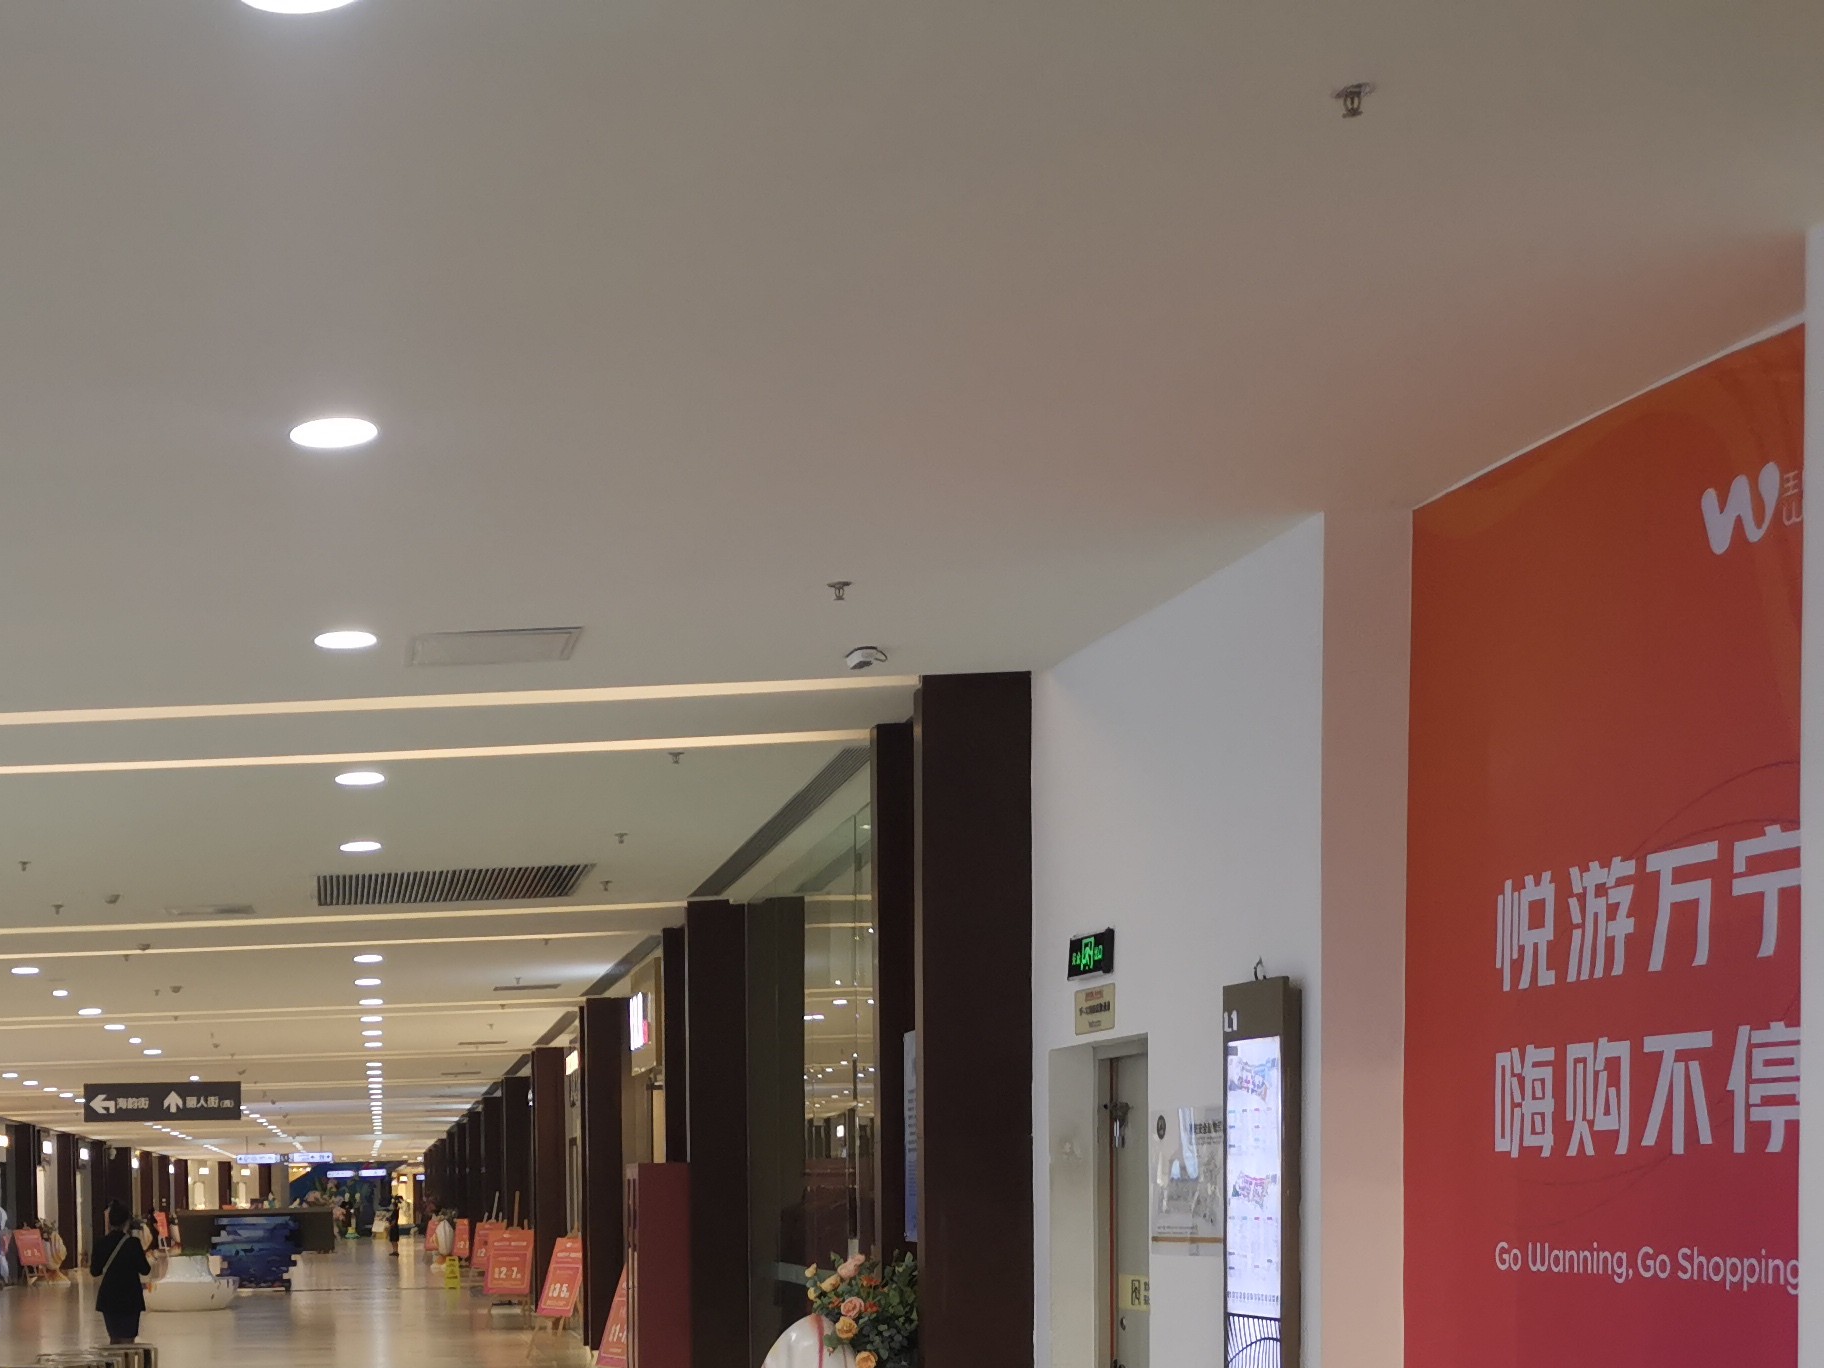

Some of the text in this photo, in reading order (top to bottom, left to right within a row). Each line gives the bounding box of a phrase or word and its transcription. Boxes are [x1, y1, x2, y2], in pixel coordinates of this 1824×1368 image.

[1496, 825, 1801, 991] 悦游万宁
[1224, 1010, 1238, 1032] L1
[1495, 1021, 1801, 1158] 嗨购不停
[1495, 1241, 1522, 1271] Go
[1637, 1246, 1670, 1279] Go
[1677, 1247, 1800, 1295] Shopping
